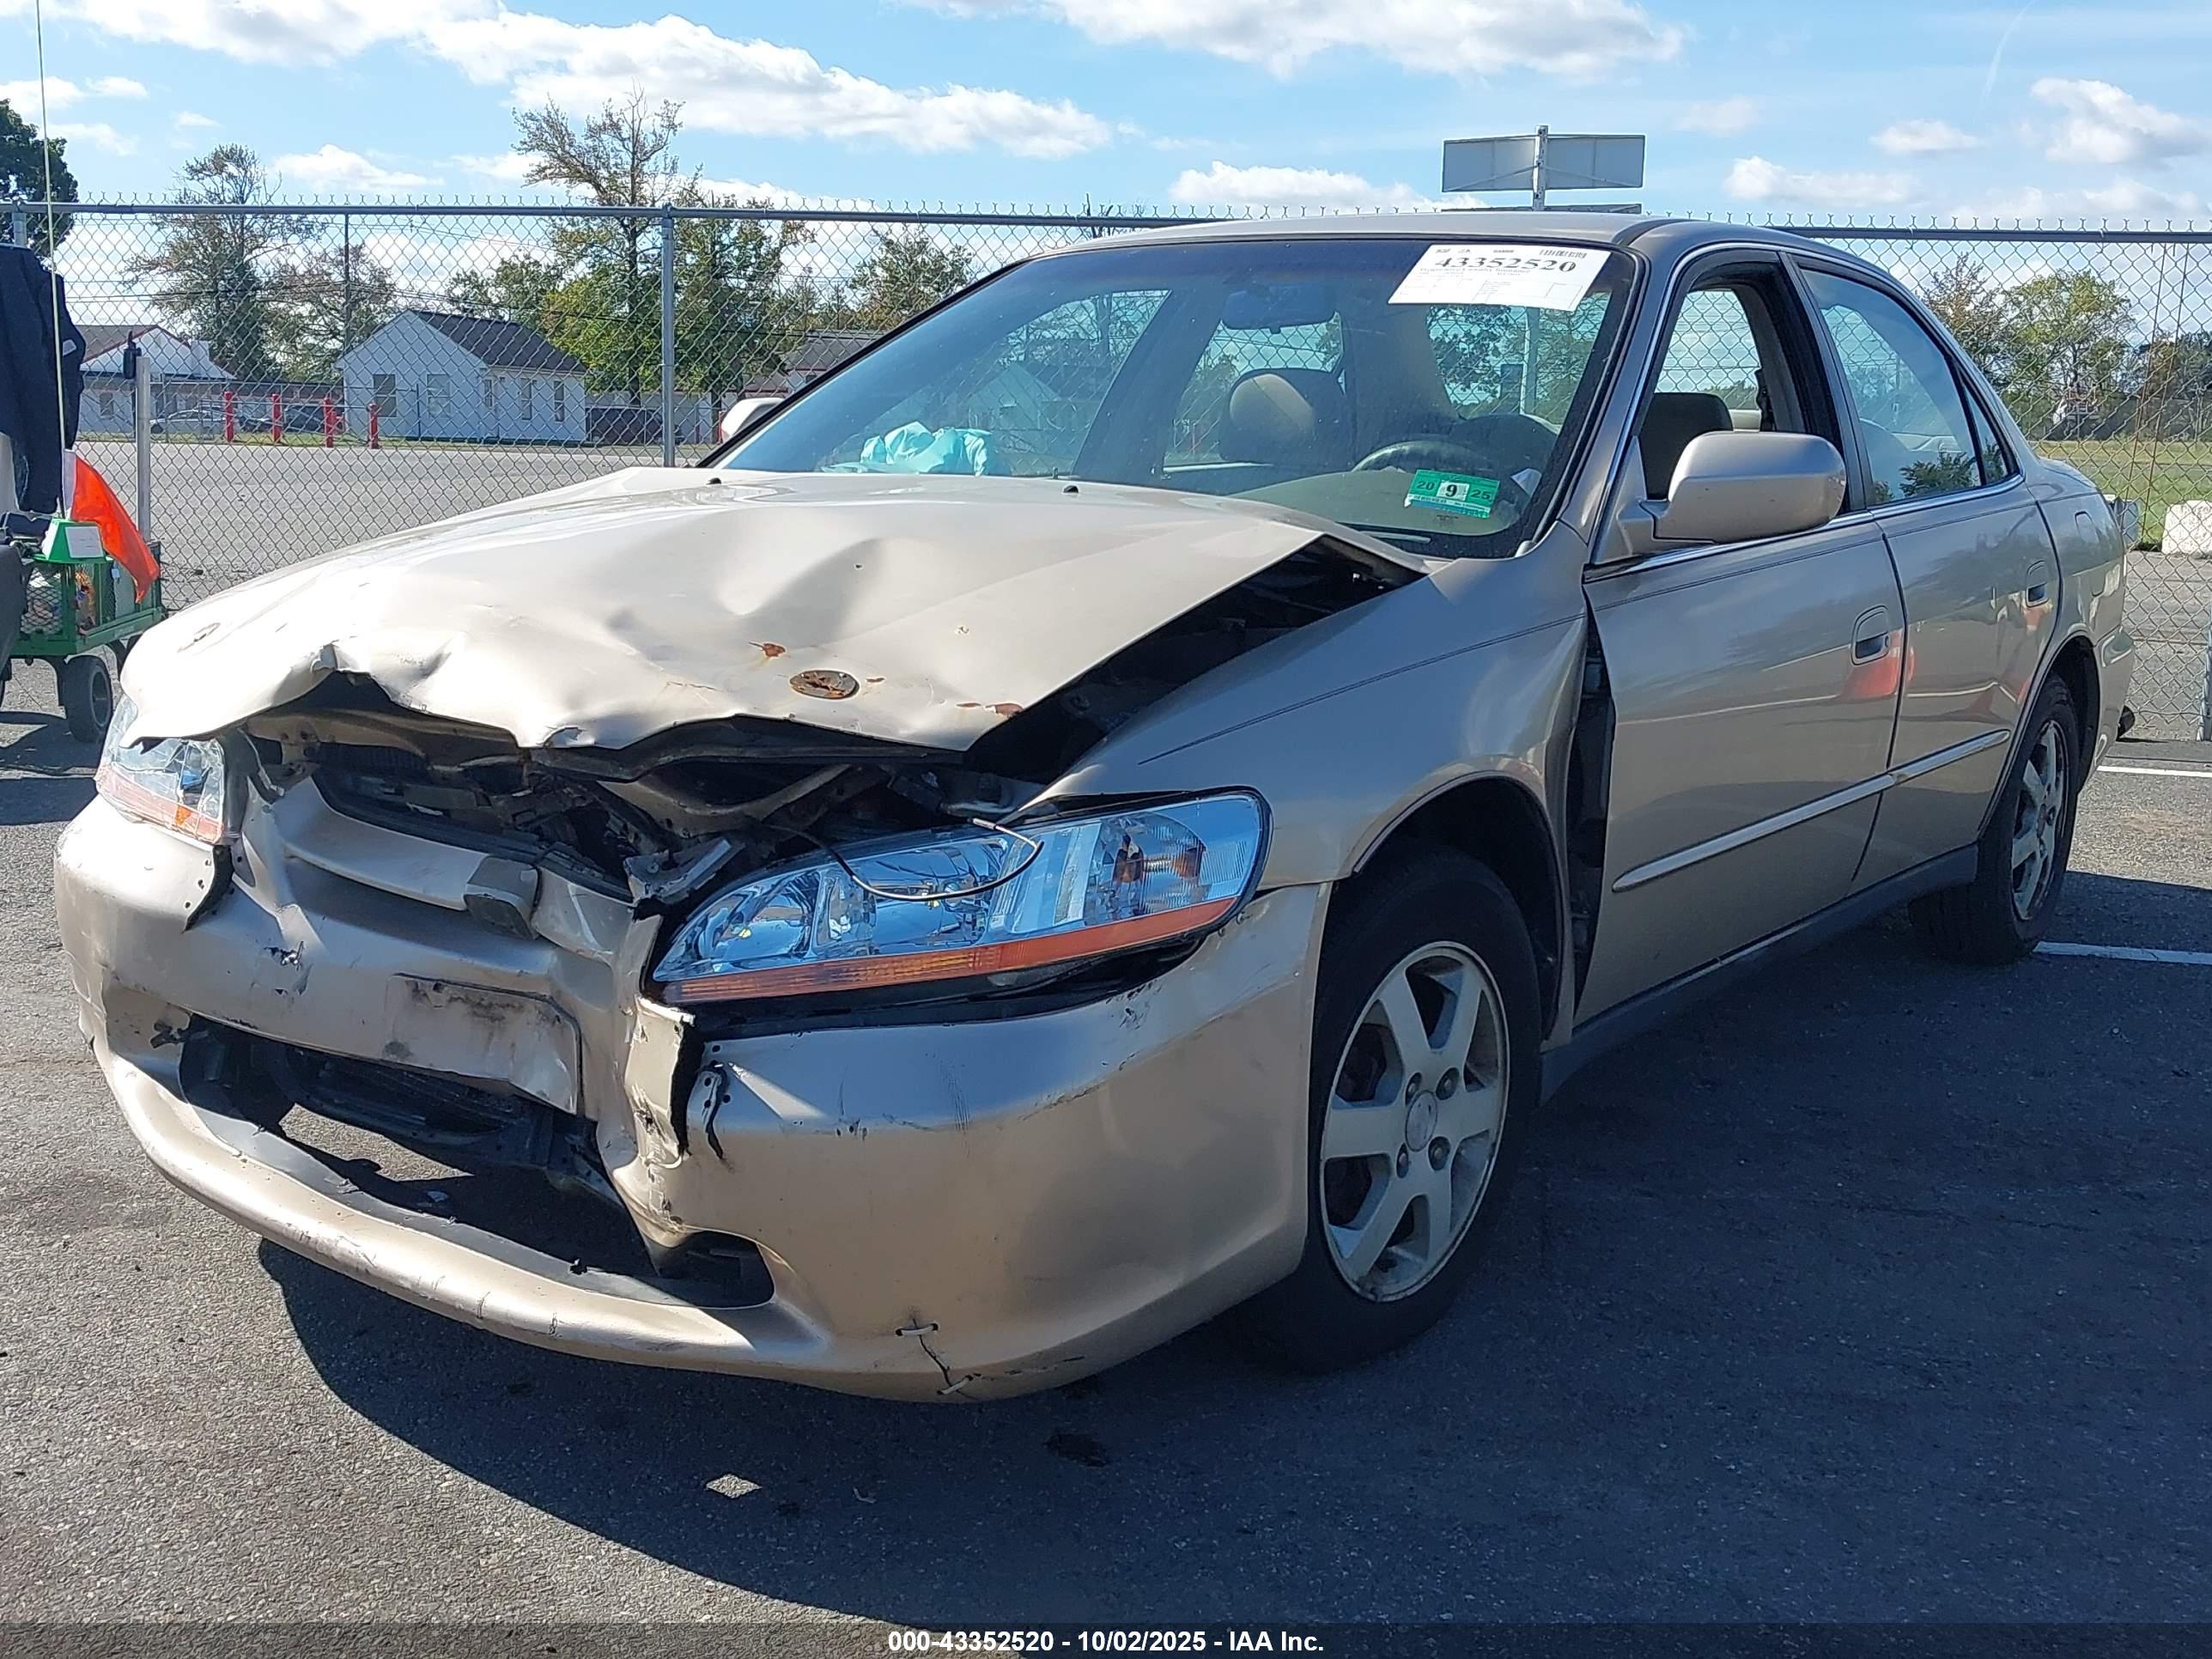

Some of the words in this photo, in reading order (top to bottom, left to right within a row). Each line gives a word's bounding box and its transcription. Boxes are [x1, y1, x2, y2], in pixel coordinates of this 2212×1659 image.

[1434, 257, 1577, 273] 43352520
[1416, 481, 1435, 490] 20
[1445, 484, 1457, 497] 9
[1470, 489, 1491, 500] 25
